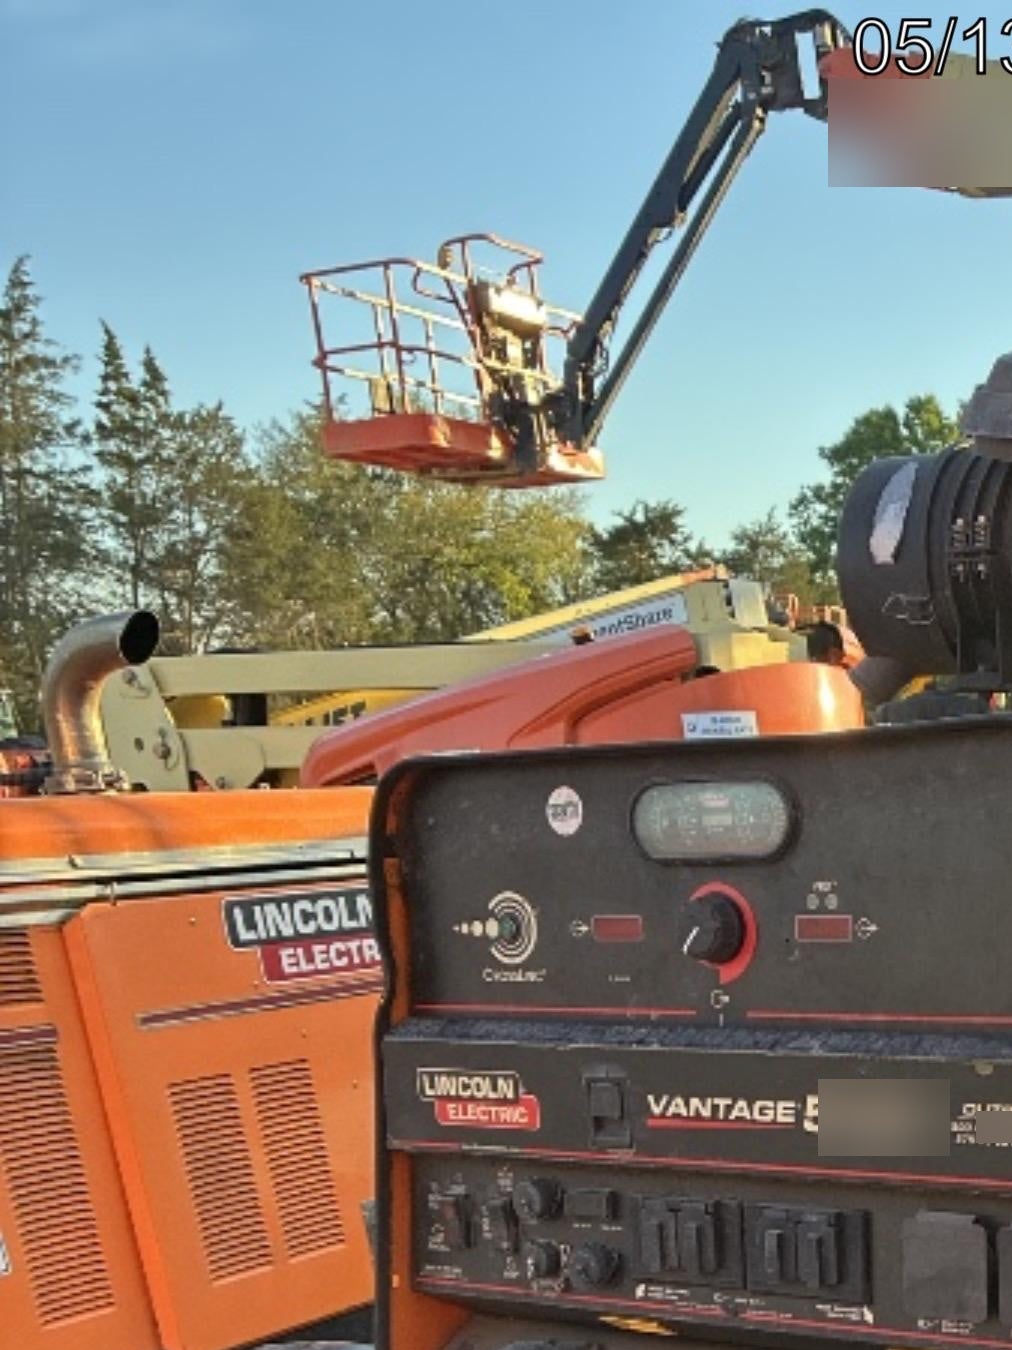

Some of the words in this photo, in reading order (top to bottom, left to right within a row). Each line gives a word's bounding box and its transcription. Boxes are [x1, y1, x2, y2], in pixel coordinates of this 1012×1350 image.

[279, 938, 382, 974] ELECTR
[421, 1074, 514, 1099] LINCOLN
[447, 1103, 529, 1124] ELECTRIC
[646, 1094, 796, 1123] VANTAGE
